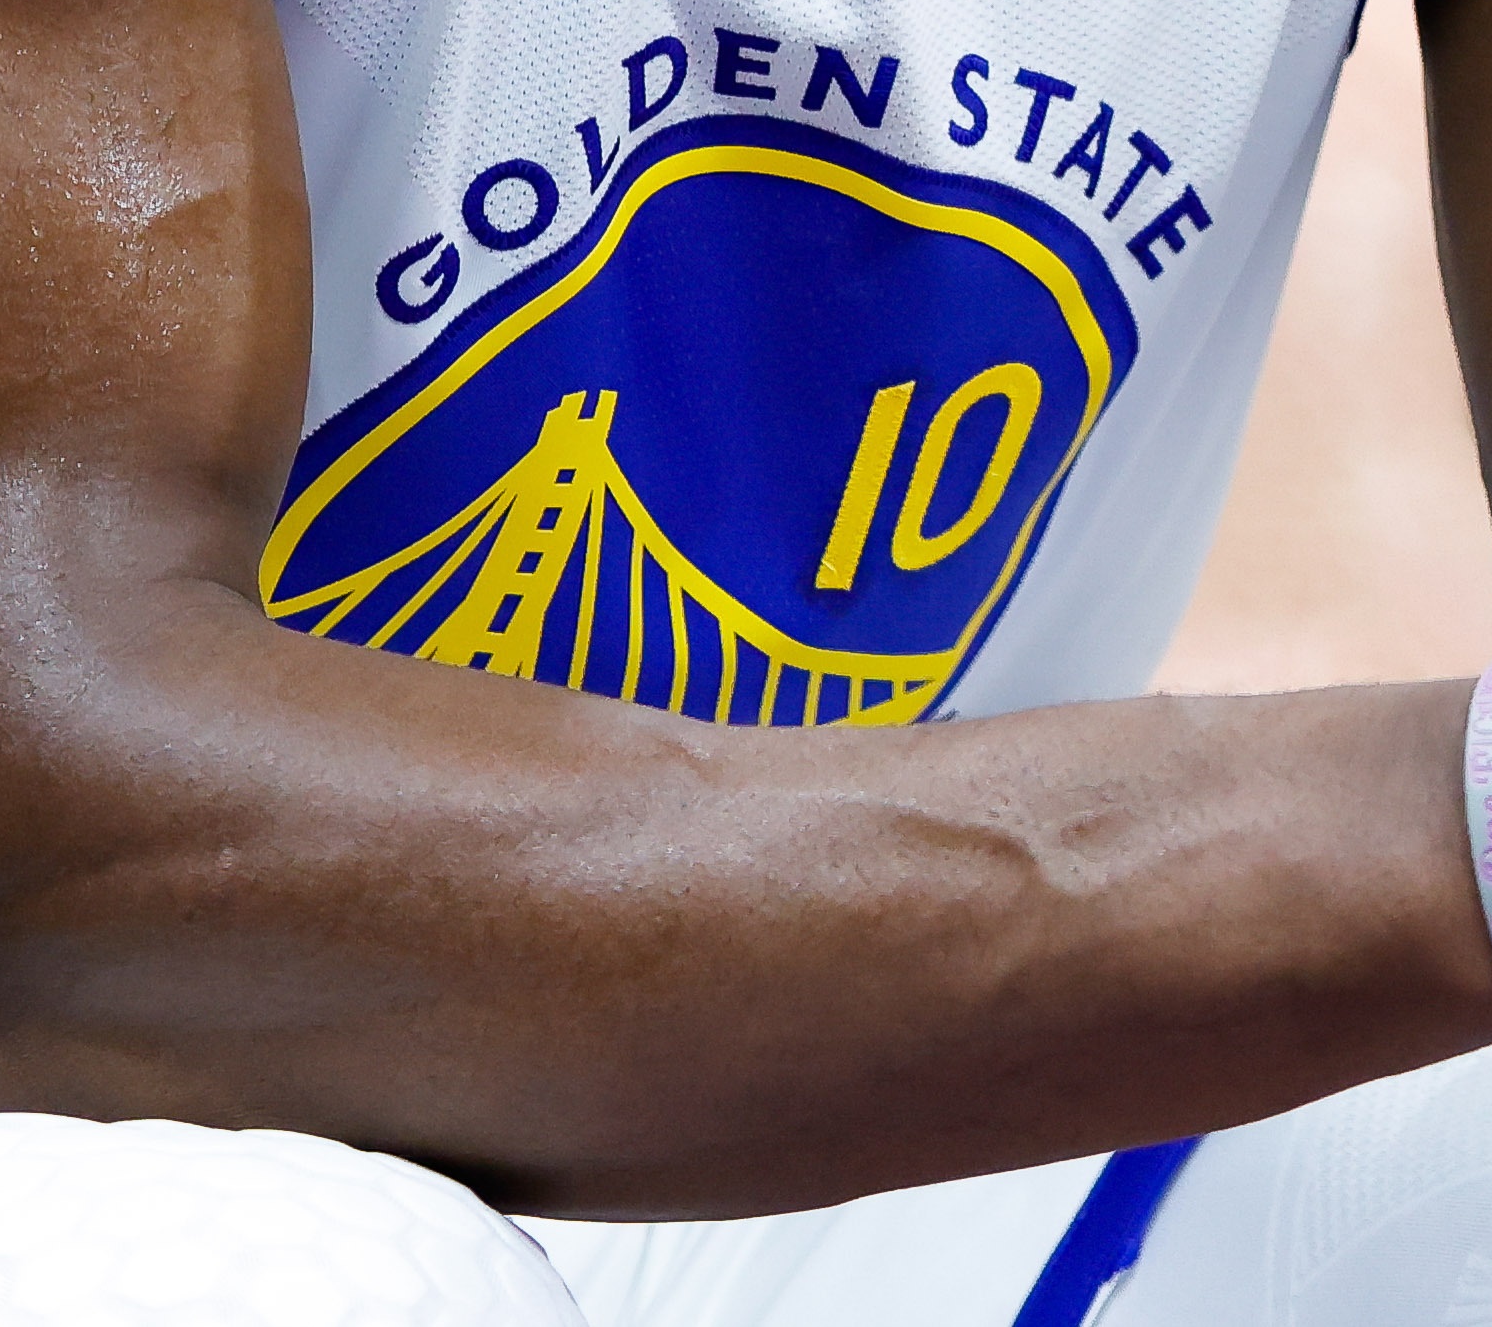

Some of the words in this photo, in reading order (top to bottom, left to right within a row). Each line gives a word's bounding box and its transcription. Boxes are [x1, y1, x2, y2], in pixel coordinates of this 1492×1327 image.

[374, 27, 901, 325] GOLDEN
[948, 52, 1214, 282] STATE
[813, 362, 1042, 591] 10
